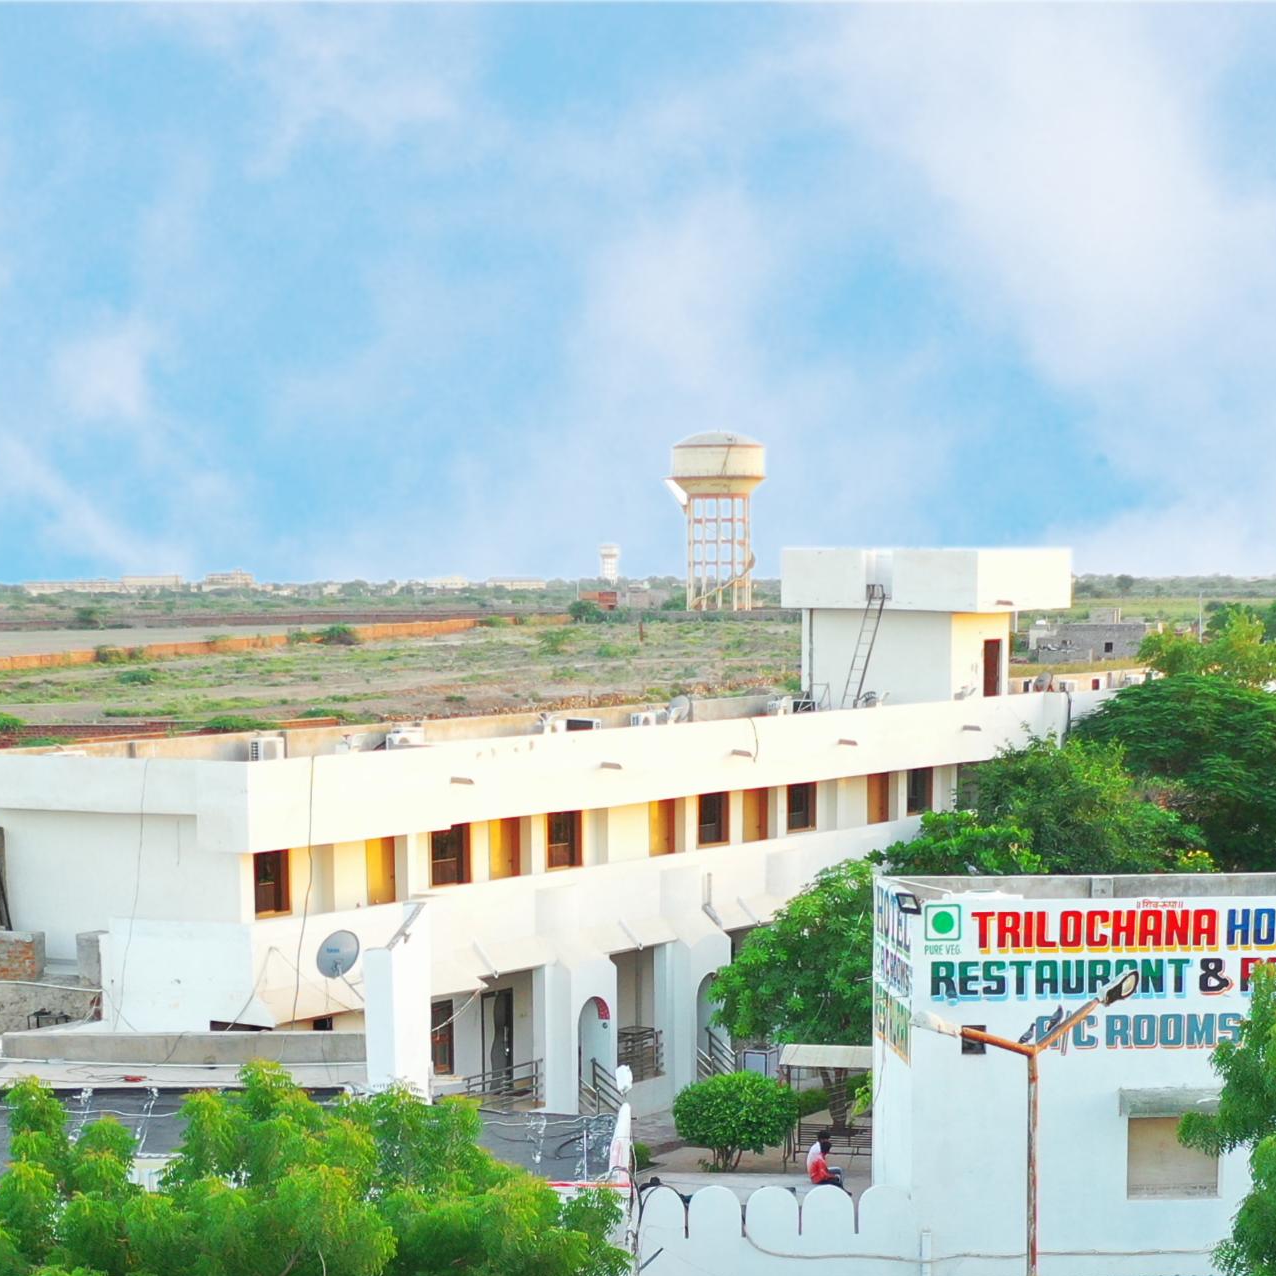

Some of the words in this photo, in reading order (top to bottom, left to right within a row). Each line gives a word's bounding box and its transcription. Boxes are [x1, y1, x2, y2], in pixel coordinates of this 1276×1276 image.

[971, 908, 1216, 952] TRILOCHANA
[924, 945, 943, 955] PURE
[1199, 957, 1234, 996] &
[1105, 1013, 1244, 1050] ROOMS
